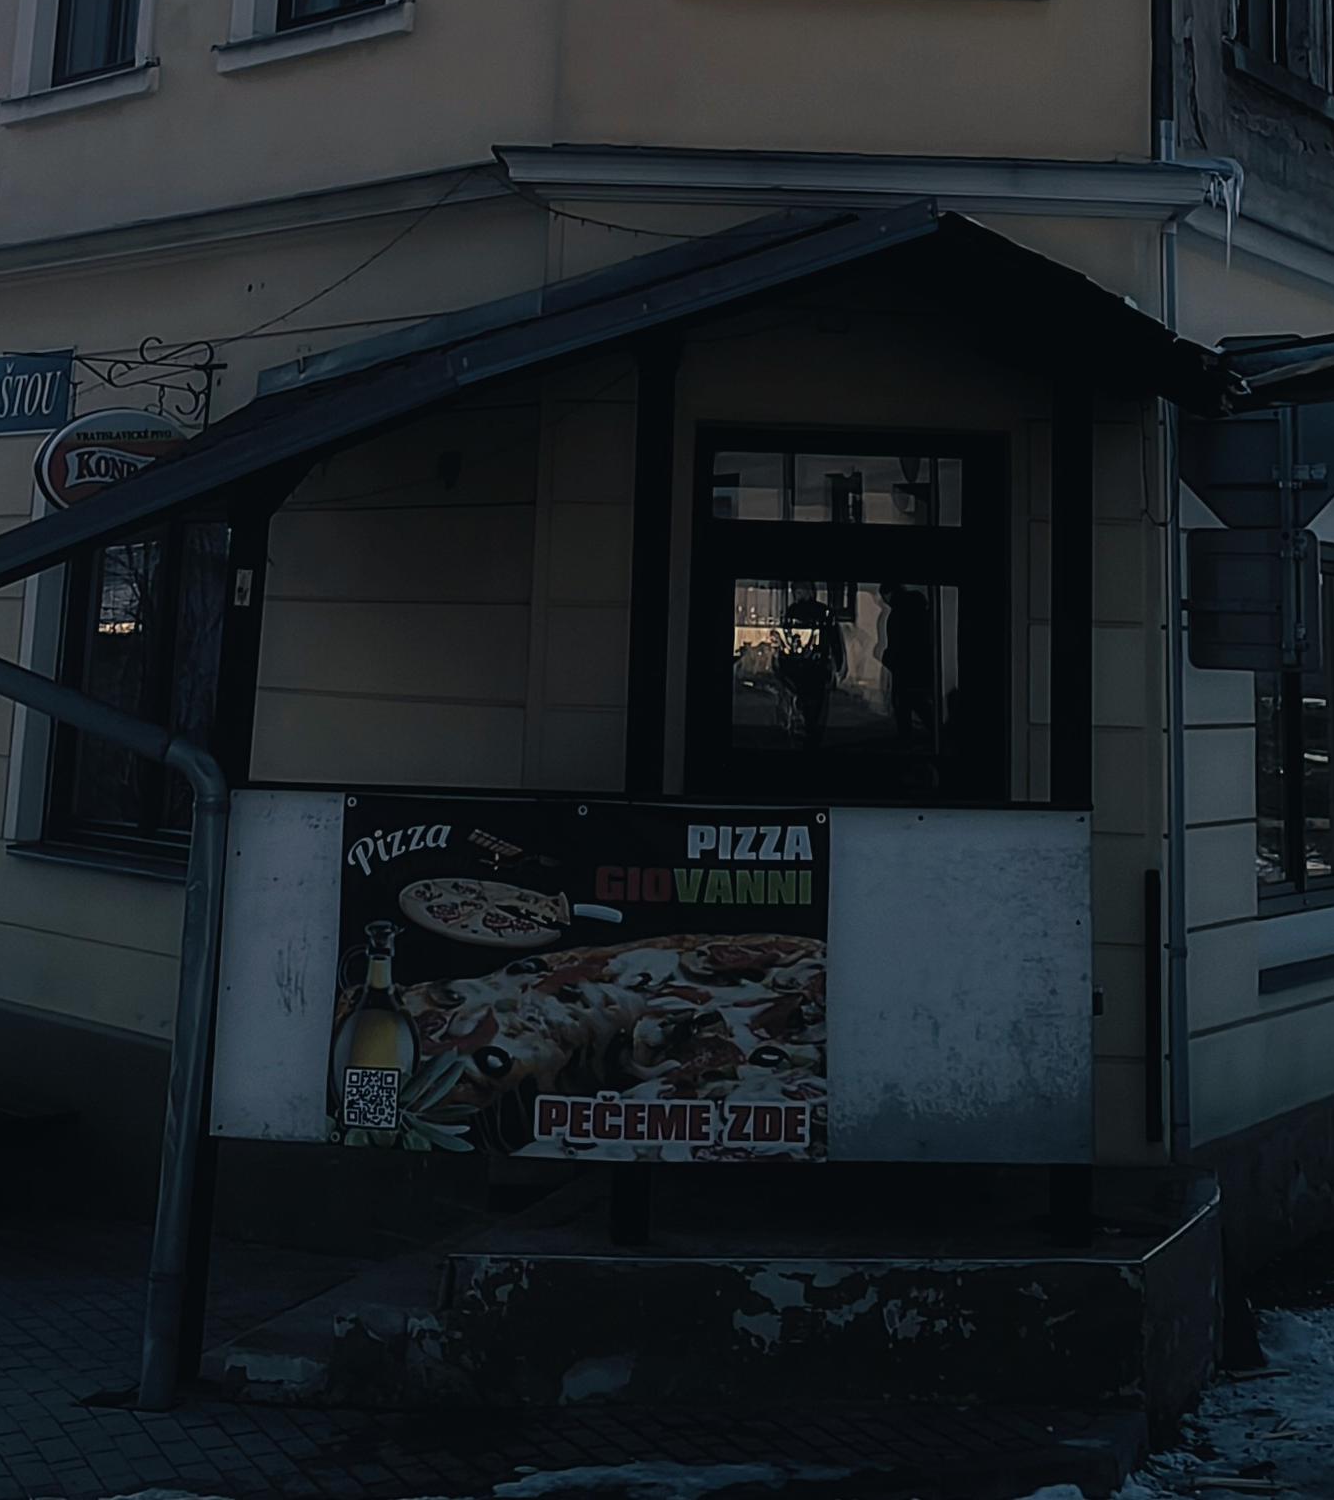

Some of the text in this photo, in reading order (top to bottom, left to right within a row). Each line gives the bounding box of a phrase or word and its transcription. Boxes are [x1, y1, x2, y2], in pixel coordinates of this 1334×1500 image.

[347, 823, 452, 876] Pizza
[687, 825, 813, 861] PIZZA
[595, 866, 813, 905] GIOVANNI
[537, 1094, 808, 1143] PEČEME ZDE
